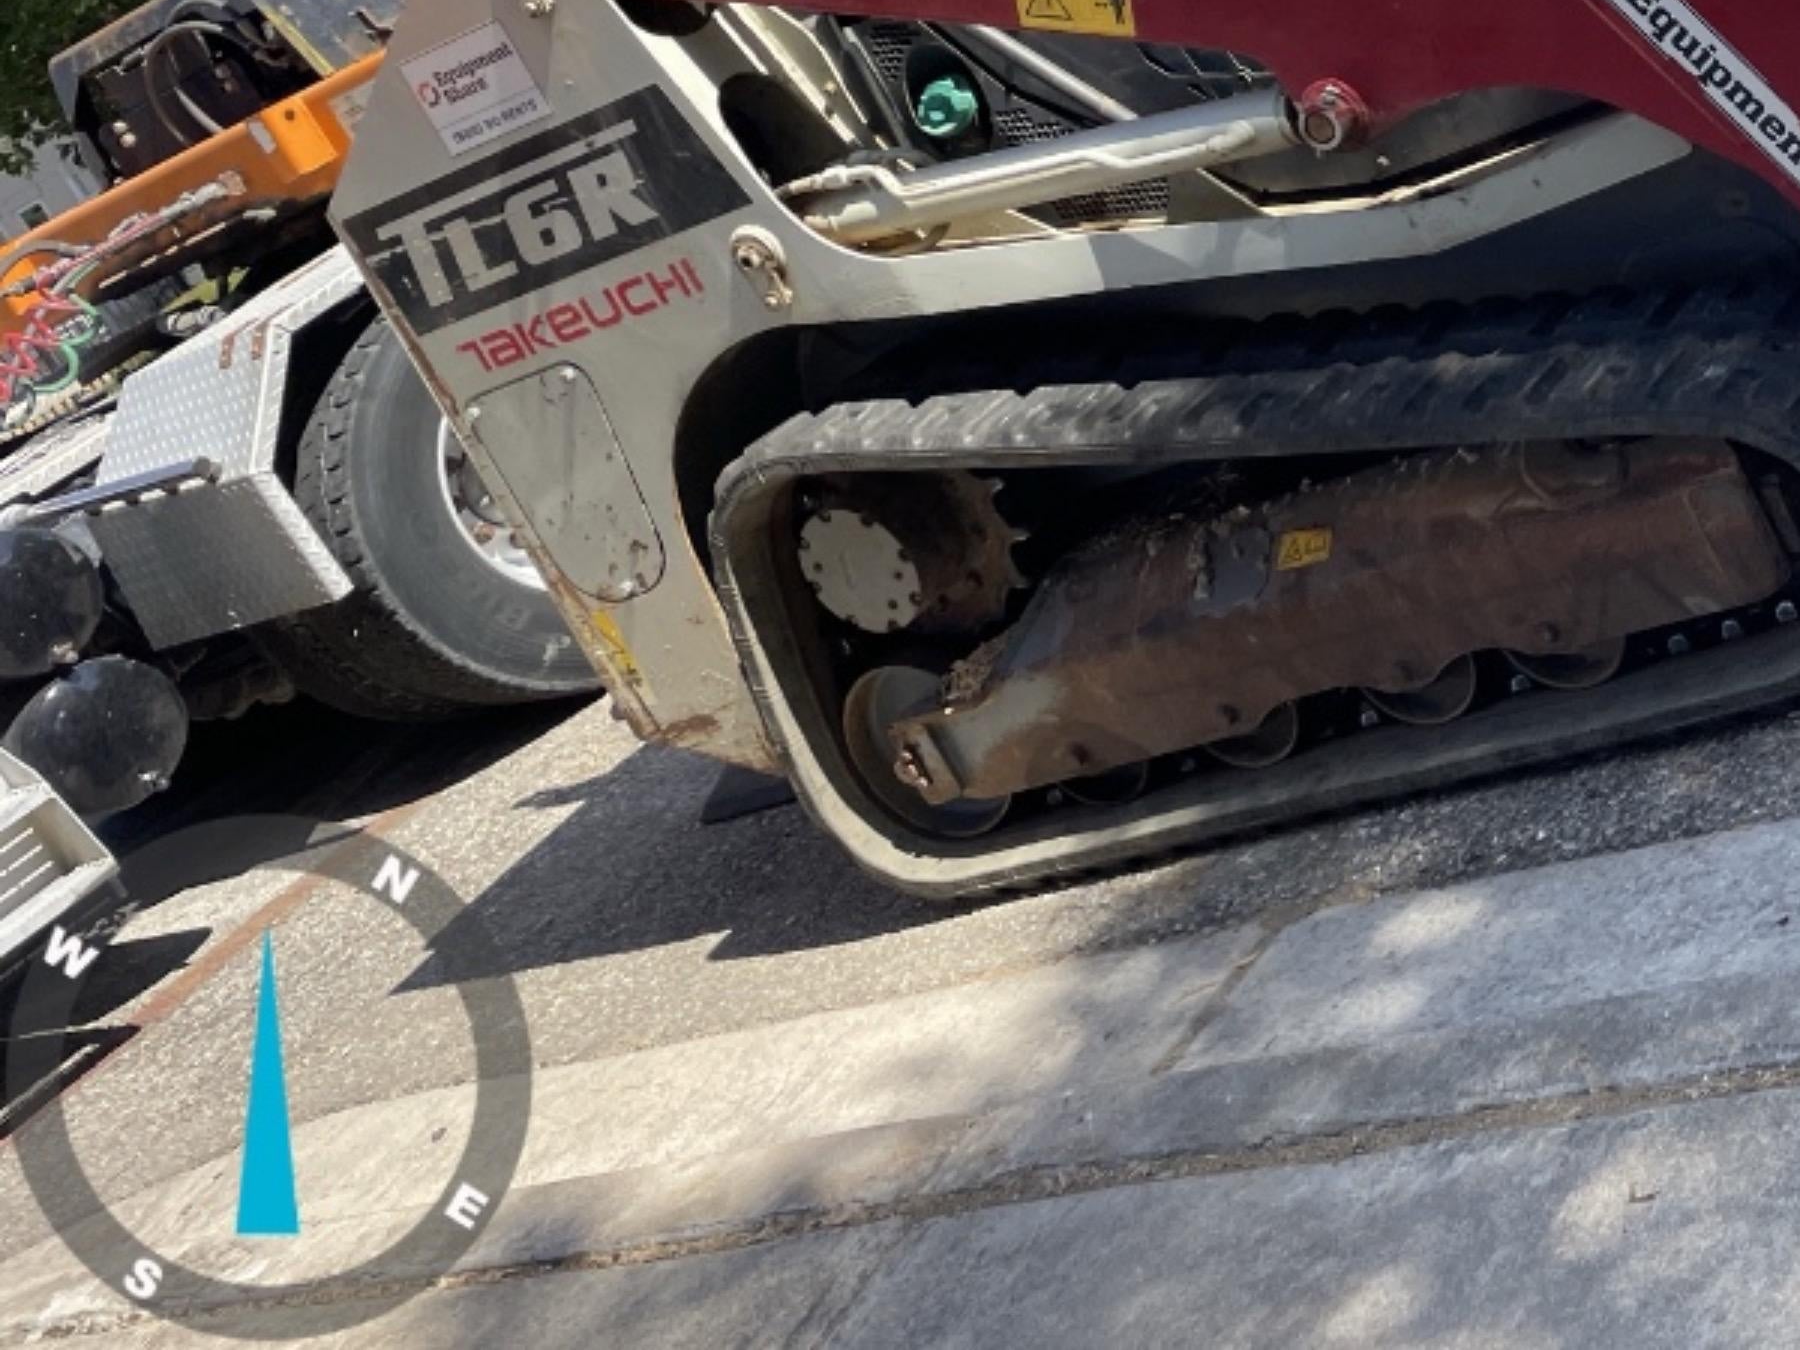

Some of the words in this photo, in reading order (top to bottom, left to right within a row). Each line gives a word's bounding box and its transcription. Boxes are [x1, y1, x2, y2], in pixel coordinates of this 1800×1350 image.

[432, 41, 513, 88] Equipment
[443, 77, 490, 104] Share
[374, 118, 662, 311] TL6R
